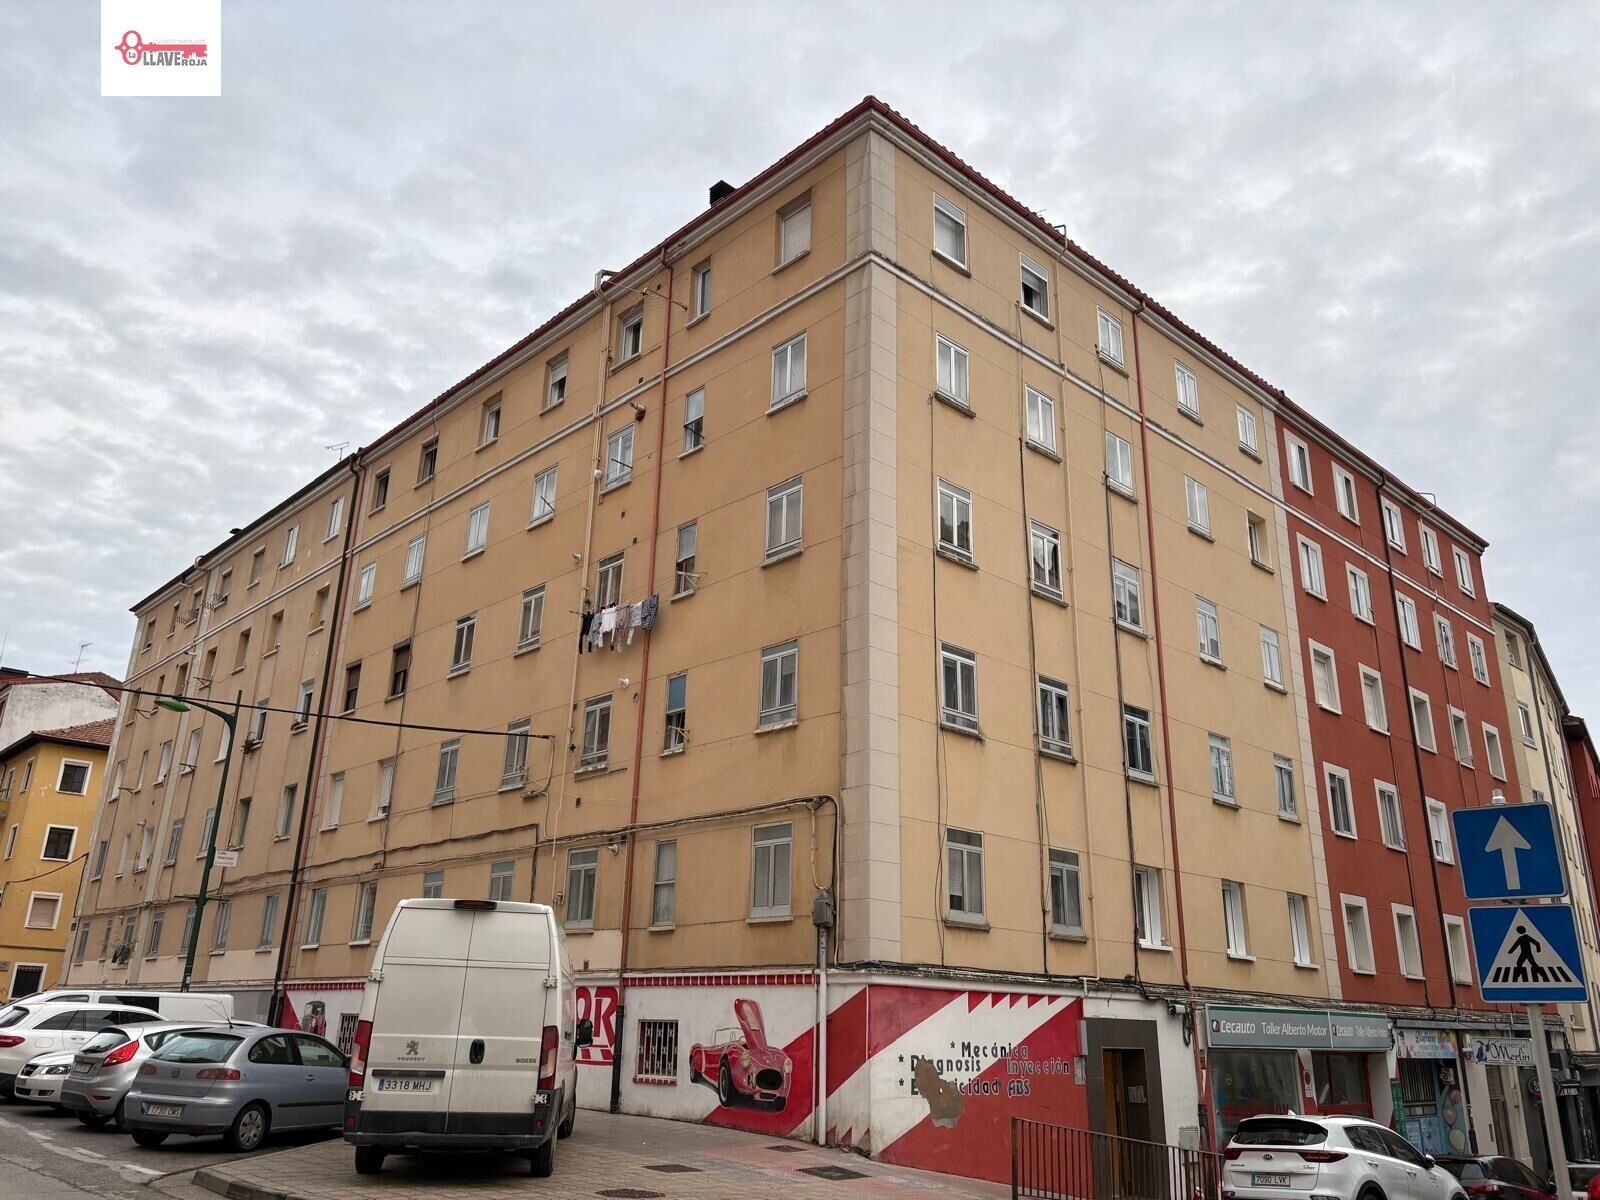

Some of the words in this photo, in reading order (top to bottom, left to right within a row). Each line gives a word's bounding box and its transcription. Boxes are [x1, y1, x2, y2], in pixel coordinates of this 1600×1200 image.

[1220, 1020, 1256, 1034] Cecauto
[1261, 1022, 1281, 1035] Taller
[1281, 1023, 1306, 1036] Alberto
[1306, 1023, 1328, 1036] Motor
[961, 1042, 1029, 1058] Mecánica
[1006, 1056, 1070, 1078] Inyección
[384, 1080, 410, 1090] 3318
[412, 1080, 432, 1091] MHJ
[1008, 1078, 1031, 1098] ABS
[1256, 1175, 1272, 1184] 7090
[1274, 1176, 1287, 1184] LVK
